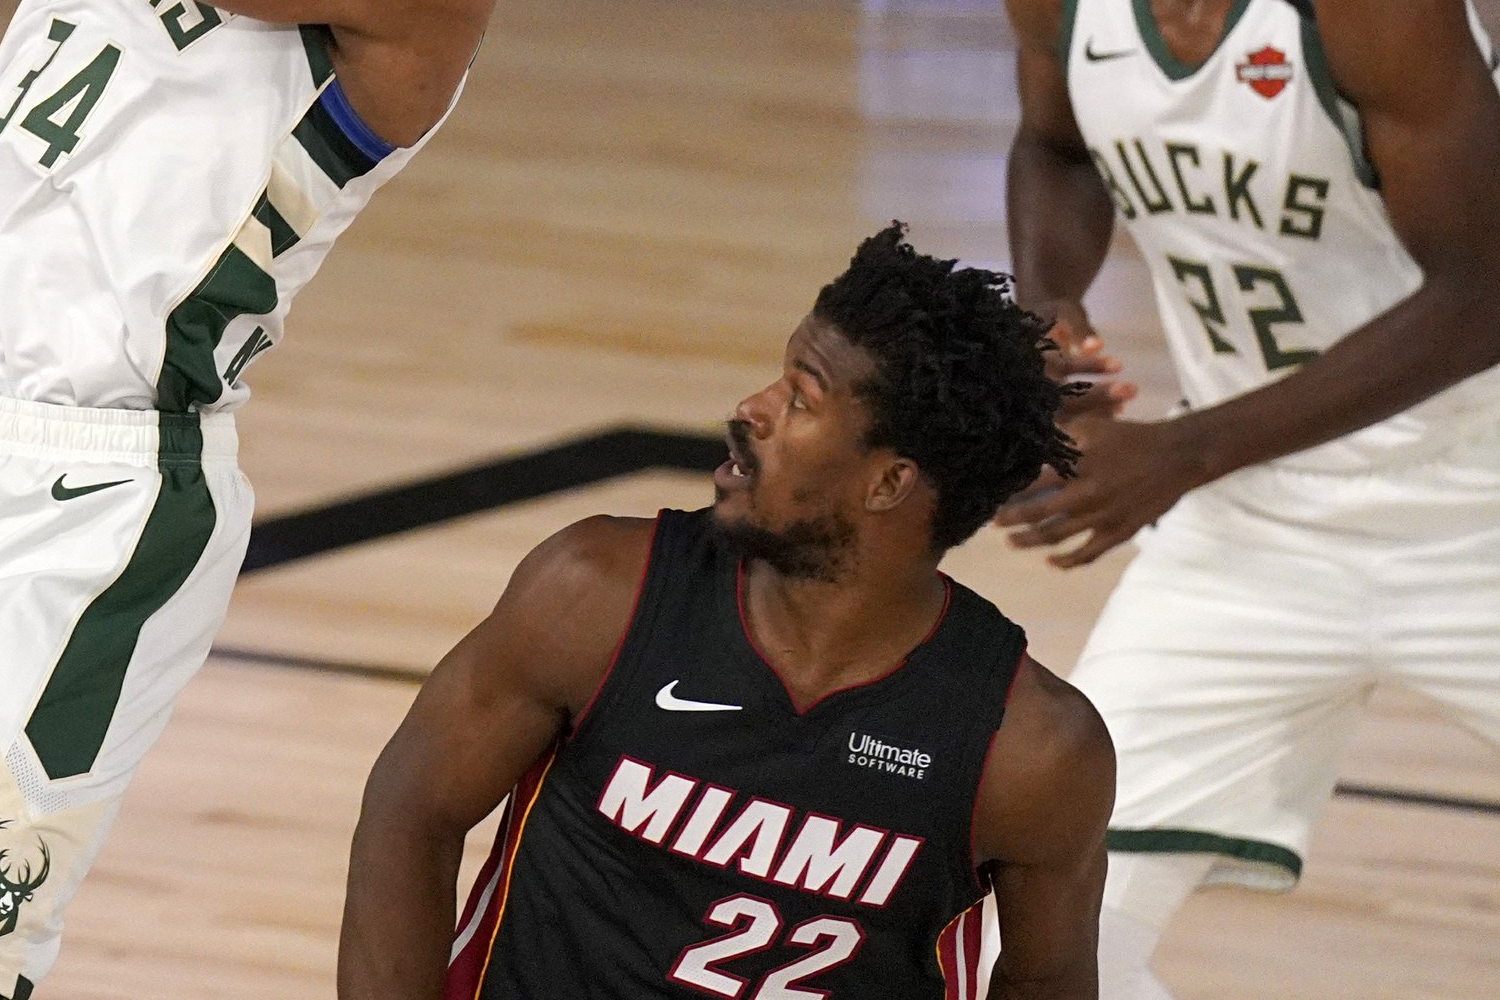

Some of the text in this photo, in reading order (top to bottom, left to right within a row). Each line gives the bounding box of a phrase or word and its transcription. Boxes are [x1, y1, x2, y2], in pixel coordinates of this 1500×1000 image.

[1167, 255, 1327, 371] 22
[848, 732, 931, 768] Ultimate
[848, 754, 925, 779] SOFTWARE
[598, 754, 926, 909] MIAMI
[666, 892, 866, 1000] 22
